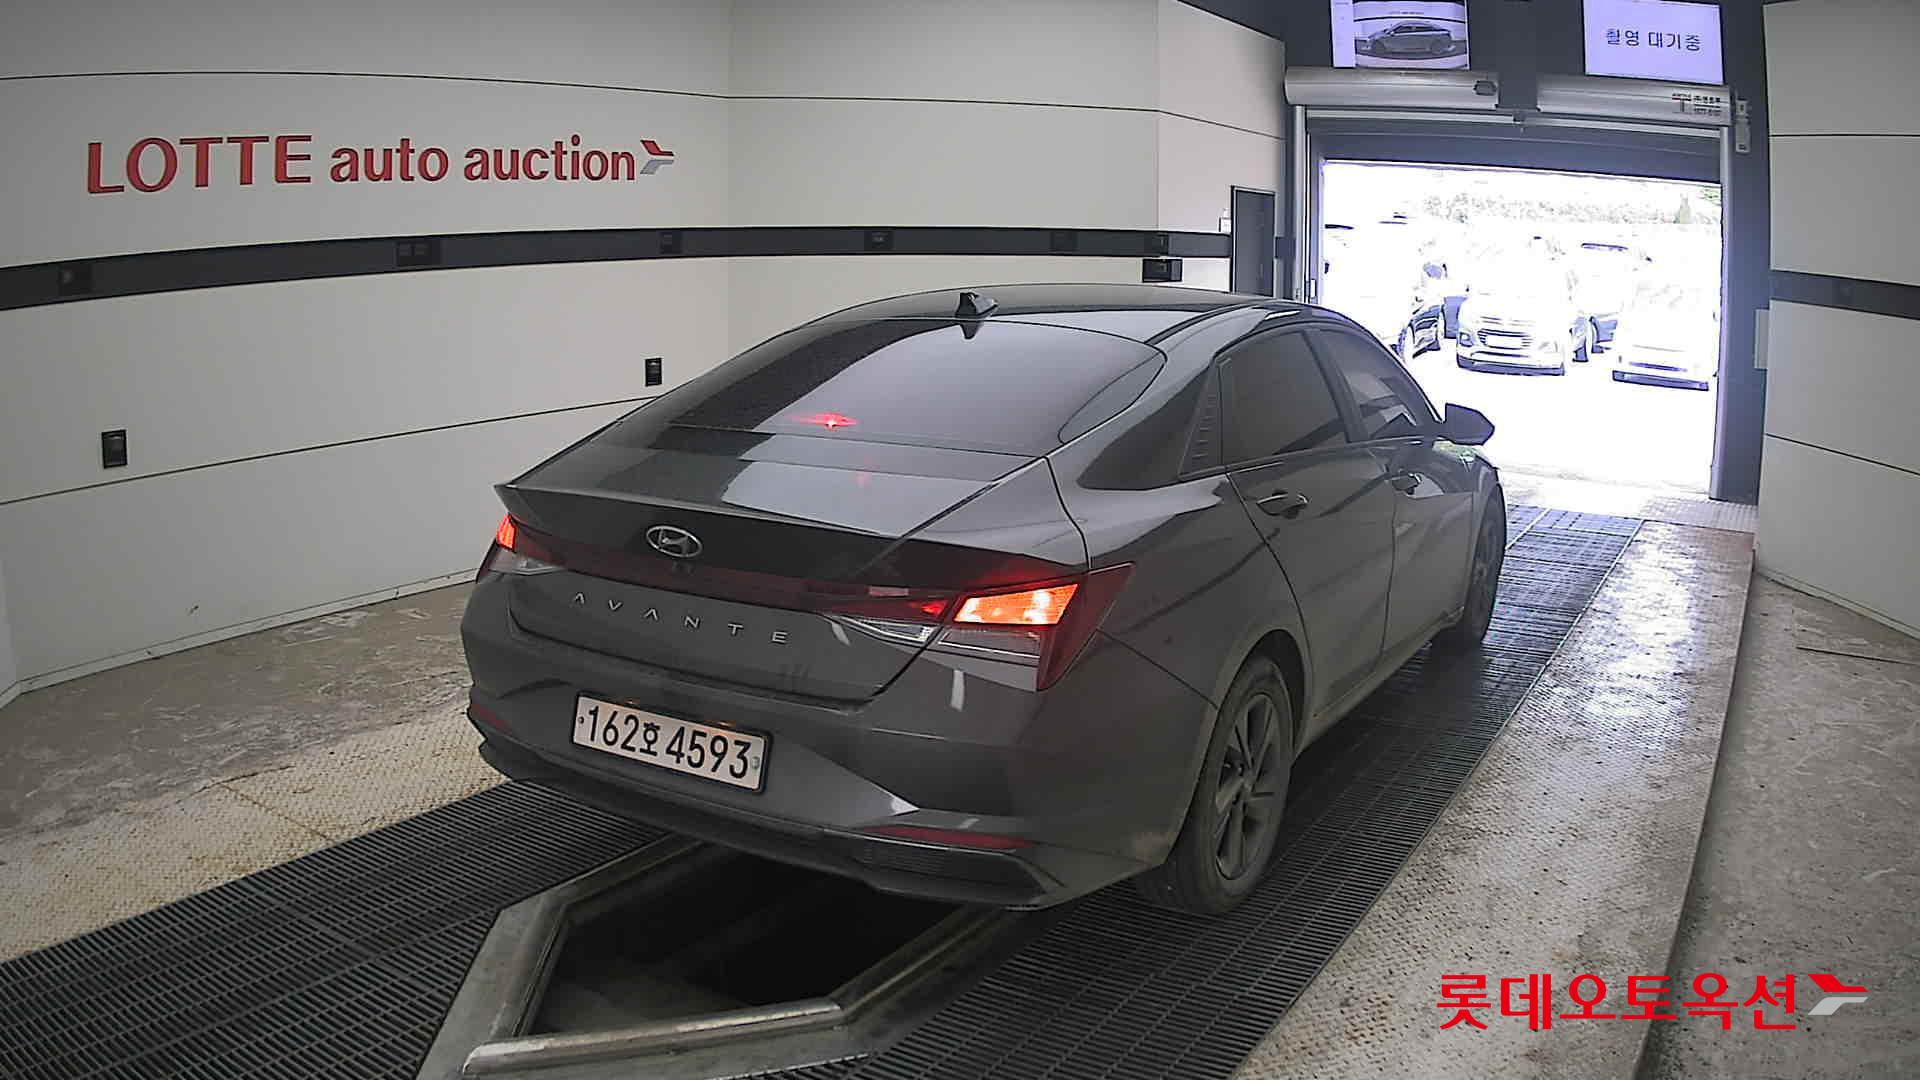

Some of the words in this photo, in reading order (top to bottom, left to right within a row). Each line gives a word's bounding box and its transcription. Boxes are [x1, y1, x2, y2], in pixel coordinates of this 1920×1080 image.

[87, 134, 312, 194] LOTTE
[329, 138, 449, 182] auto
[463, 134, 636, 182] auction
[572, 592, 789, 645] AVANTE
[588, 705, 661, 757] 162호
[665, 726, 752, 779] 4593
